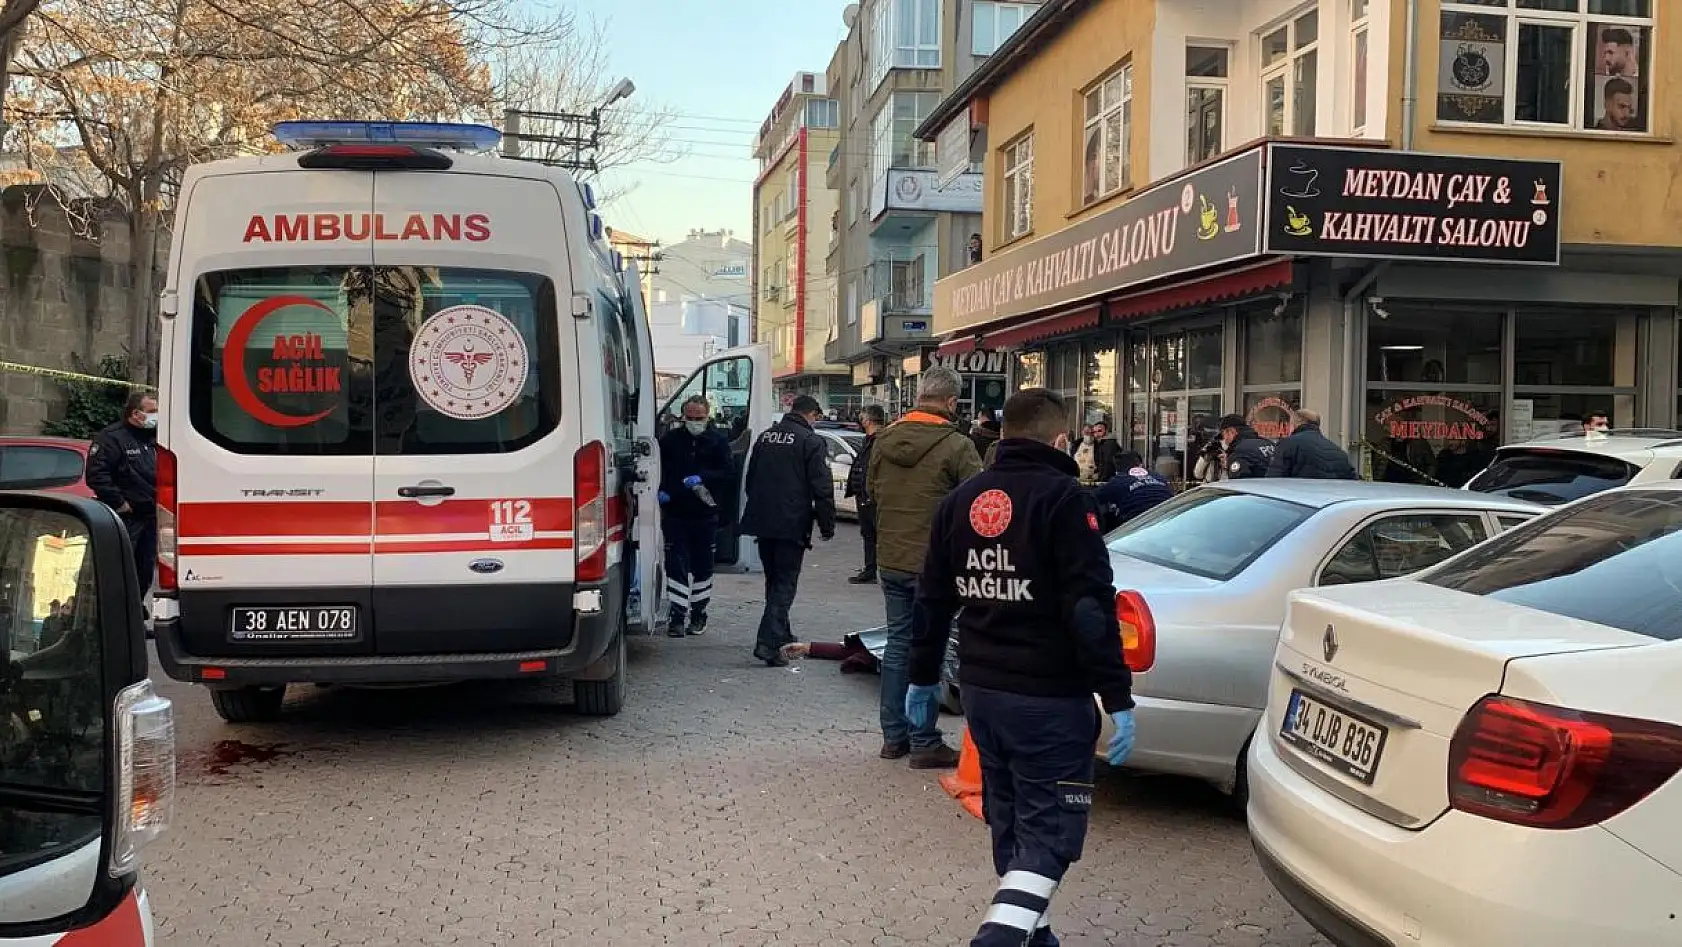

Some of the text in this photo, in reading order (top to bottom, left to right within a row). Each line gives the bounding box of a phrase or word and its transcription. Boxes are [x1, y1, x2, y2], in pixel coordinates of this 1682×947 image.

[1342, 168, 1511, 208] MEYDAN ÇAY &
[243, 213, 492, 243] AMBULANS
[1319, 212, 1530, 248] KAHVALTI SALONU
[952, 205, 1179, 317] MEYDAN ÇAY & KAHVALTI SALONU
[272, 331, 324, 360] ACİL
[257, 361, 341, 392] SAĞLIK
[762, 431, 795, 444] POLİS
[1390, 421, 1475, 440] MEYDAN
[242, 489, 324, 497] TRANSIT
[491, 500, 532, 524] 112
[501, 524, 523, 534] ACİL
[966, 544, 1016, 572] ACİL
[955, 573, 1034, 601] SAĞLIK
[246, 610, 351, 630] 38 AEN 078
[1302, 662, 1349, 692] SYMBOL
[1293, 699, 1312, 735] 34
[1311, 707, 1342, 749] DJB
[1342, 721, 1376, 766] 836
